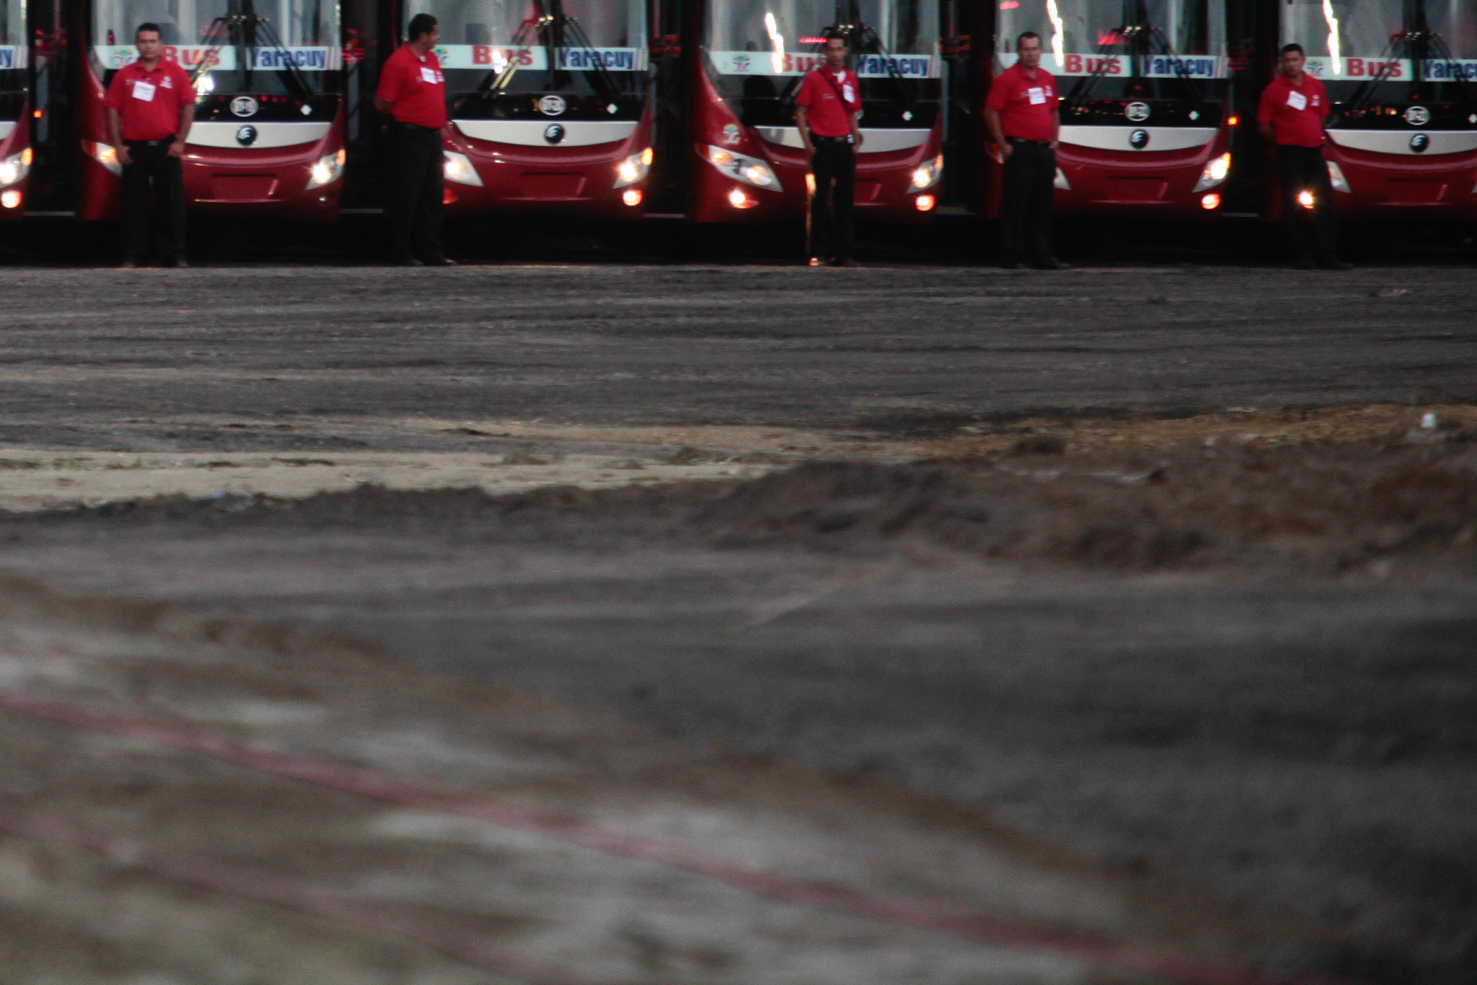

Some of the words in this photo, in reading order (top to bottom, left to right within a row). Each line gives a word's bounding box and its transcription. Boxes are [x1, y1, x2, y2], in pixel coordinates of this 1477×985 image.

[161, 46, 221, 66] Bus
[1065, 54, 1122, 74] Bus
[1346, 58, 1403, 78] Bus
